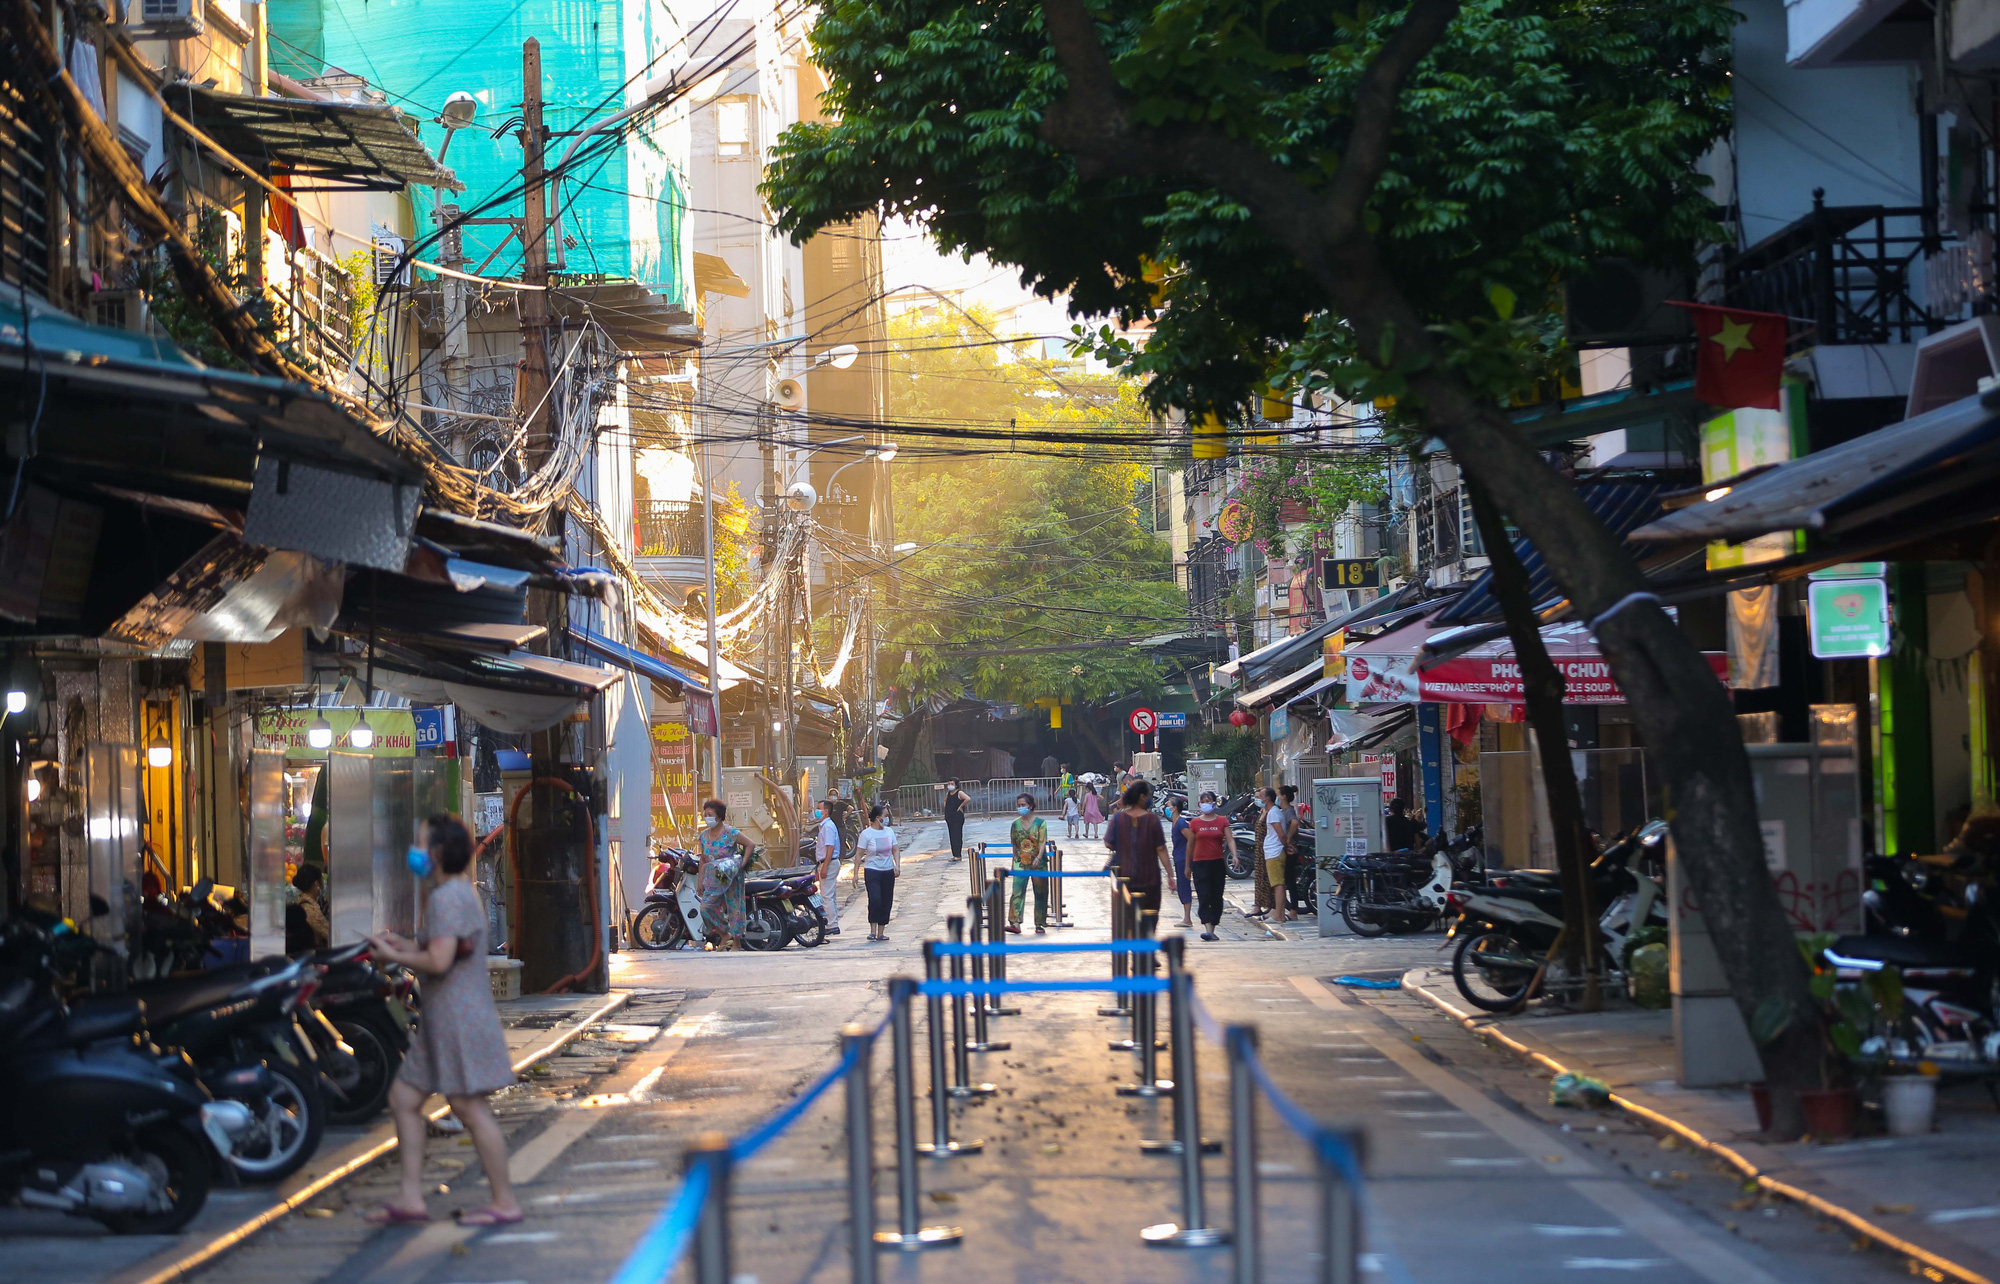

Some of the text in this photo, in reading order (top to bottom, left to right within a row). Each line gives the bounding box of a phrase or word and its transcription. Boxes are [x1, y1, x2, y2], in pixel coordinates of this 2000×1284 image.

[1567, 663, 1610, 678] CHUY
[1584, 683, 1611, 692] SOUP
[386, 731, 410, 748] KHẨU
